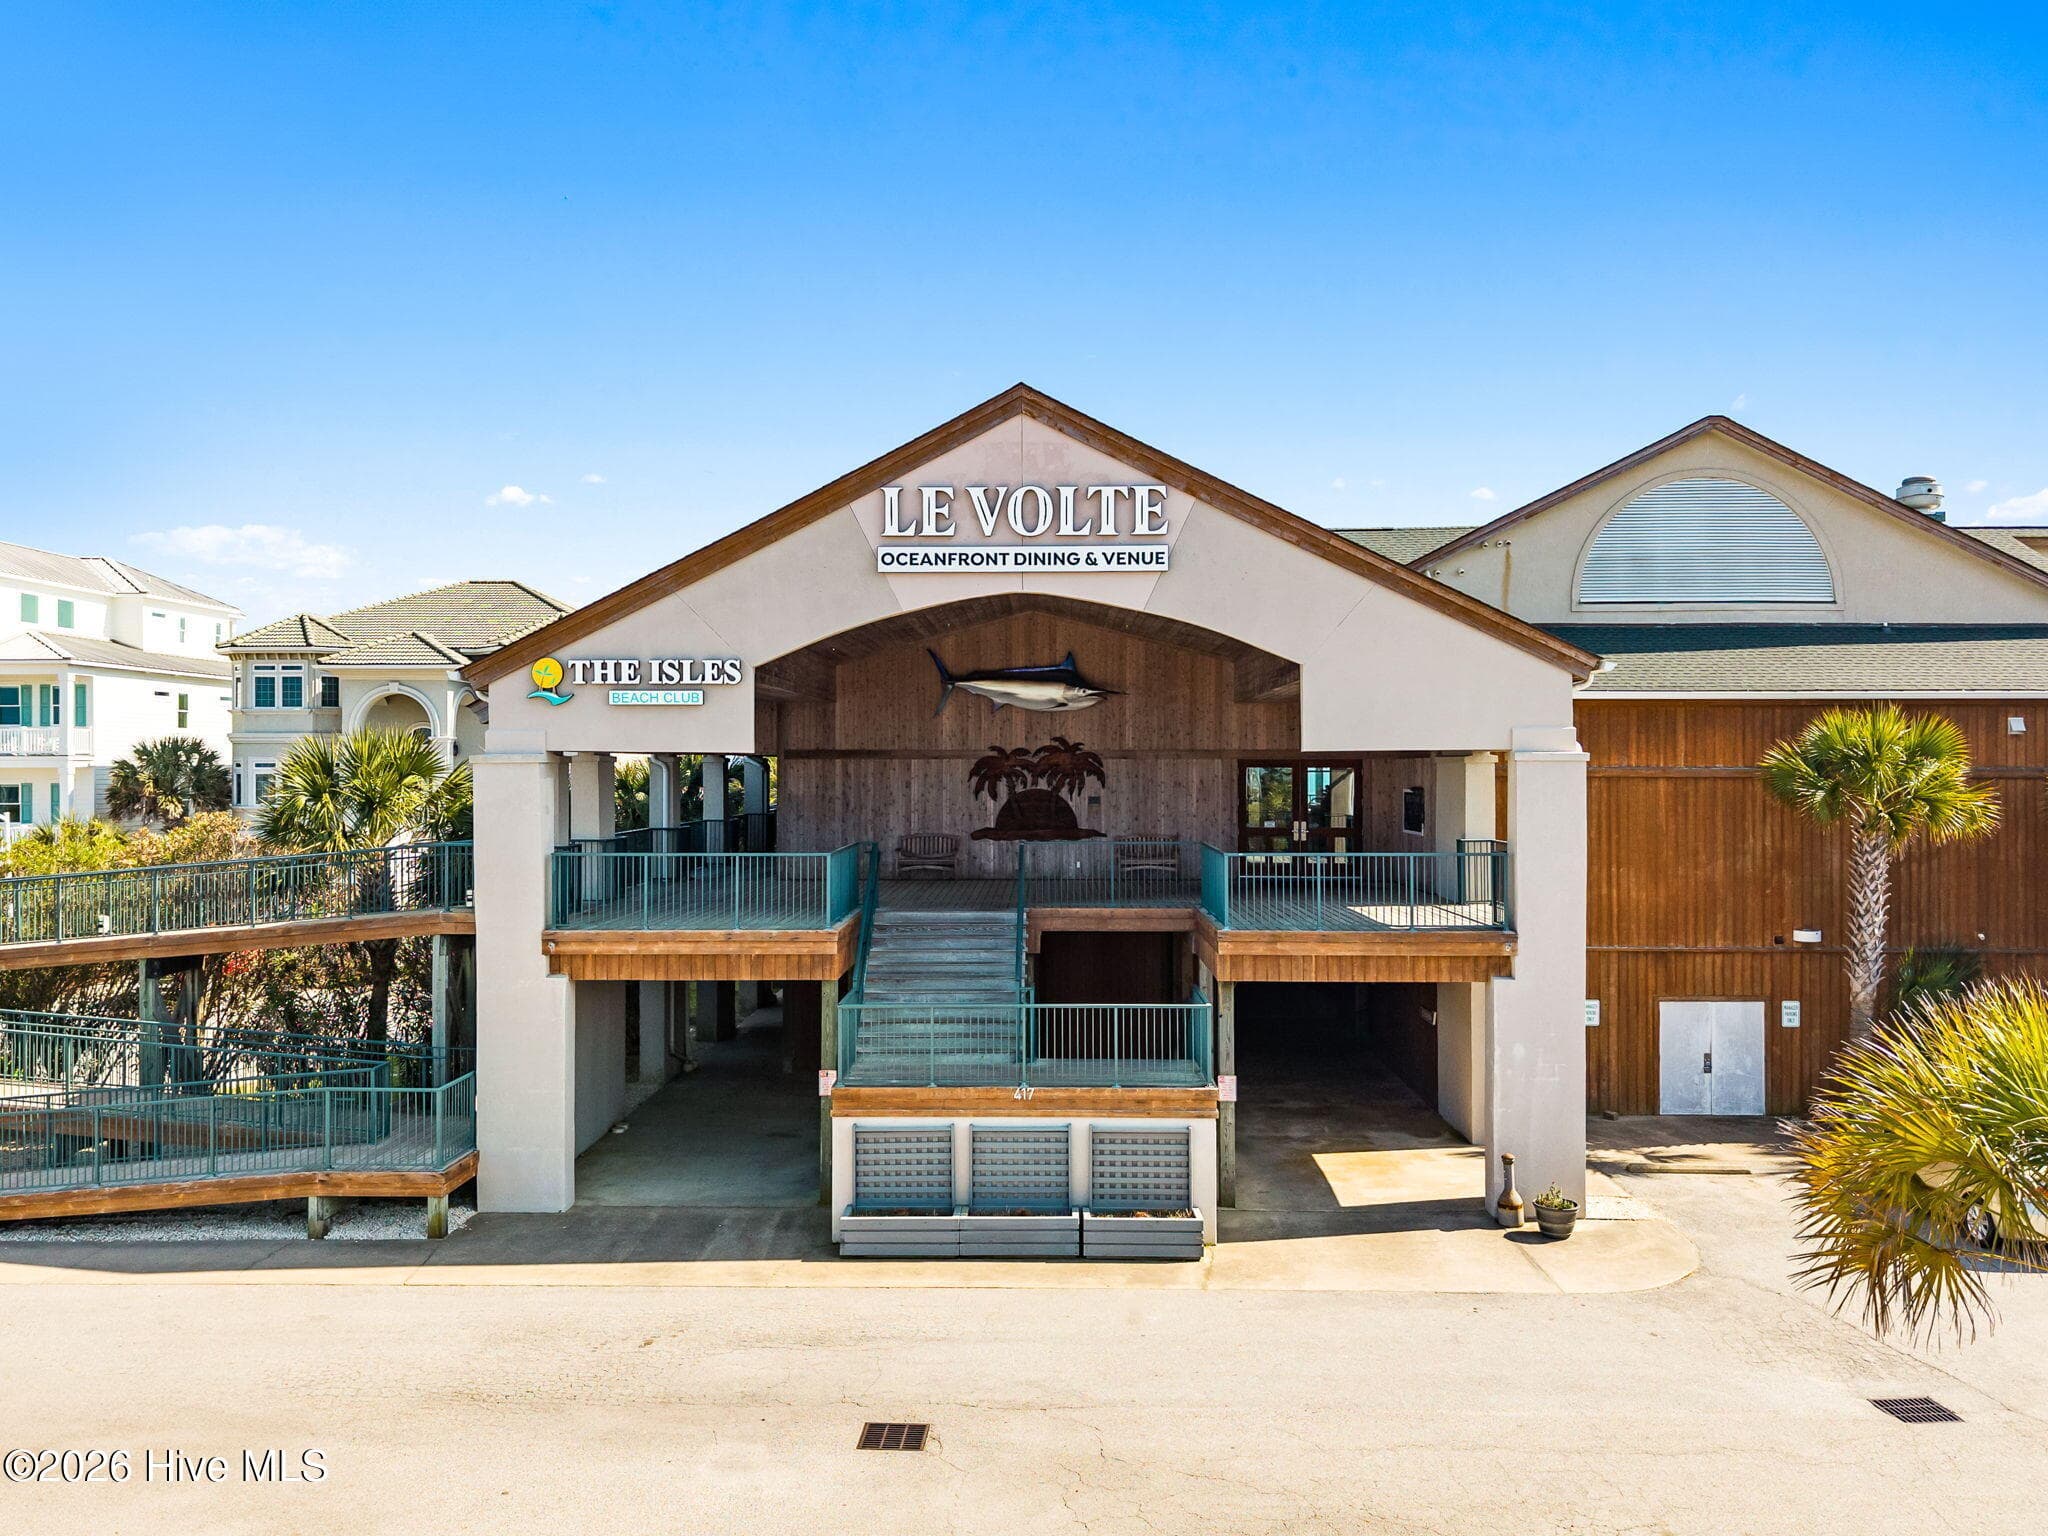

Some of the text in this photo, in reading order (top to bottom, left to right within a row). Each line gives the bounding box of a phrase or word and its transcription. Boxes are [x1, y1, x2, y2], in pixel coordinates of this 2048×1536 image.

[880, 485, 1169, 537] LE VOLTE
[881, 551, 1166, 566] OCEANFRONT DINING & VENUE
[567, 658, 743, 686] THE ISLES
[611, 692, 700, 704] BEACH CLUB
[1013, 1087, 1035, 1101] 417
